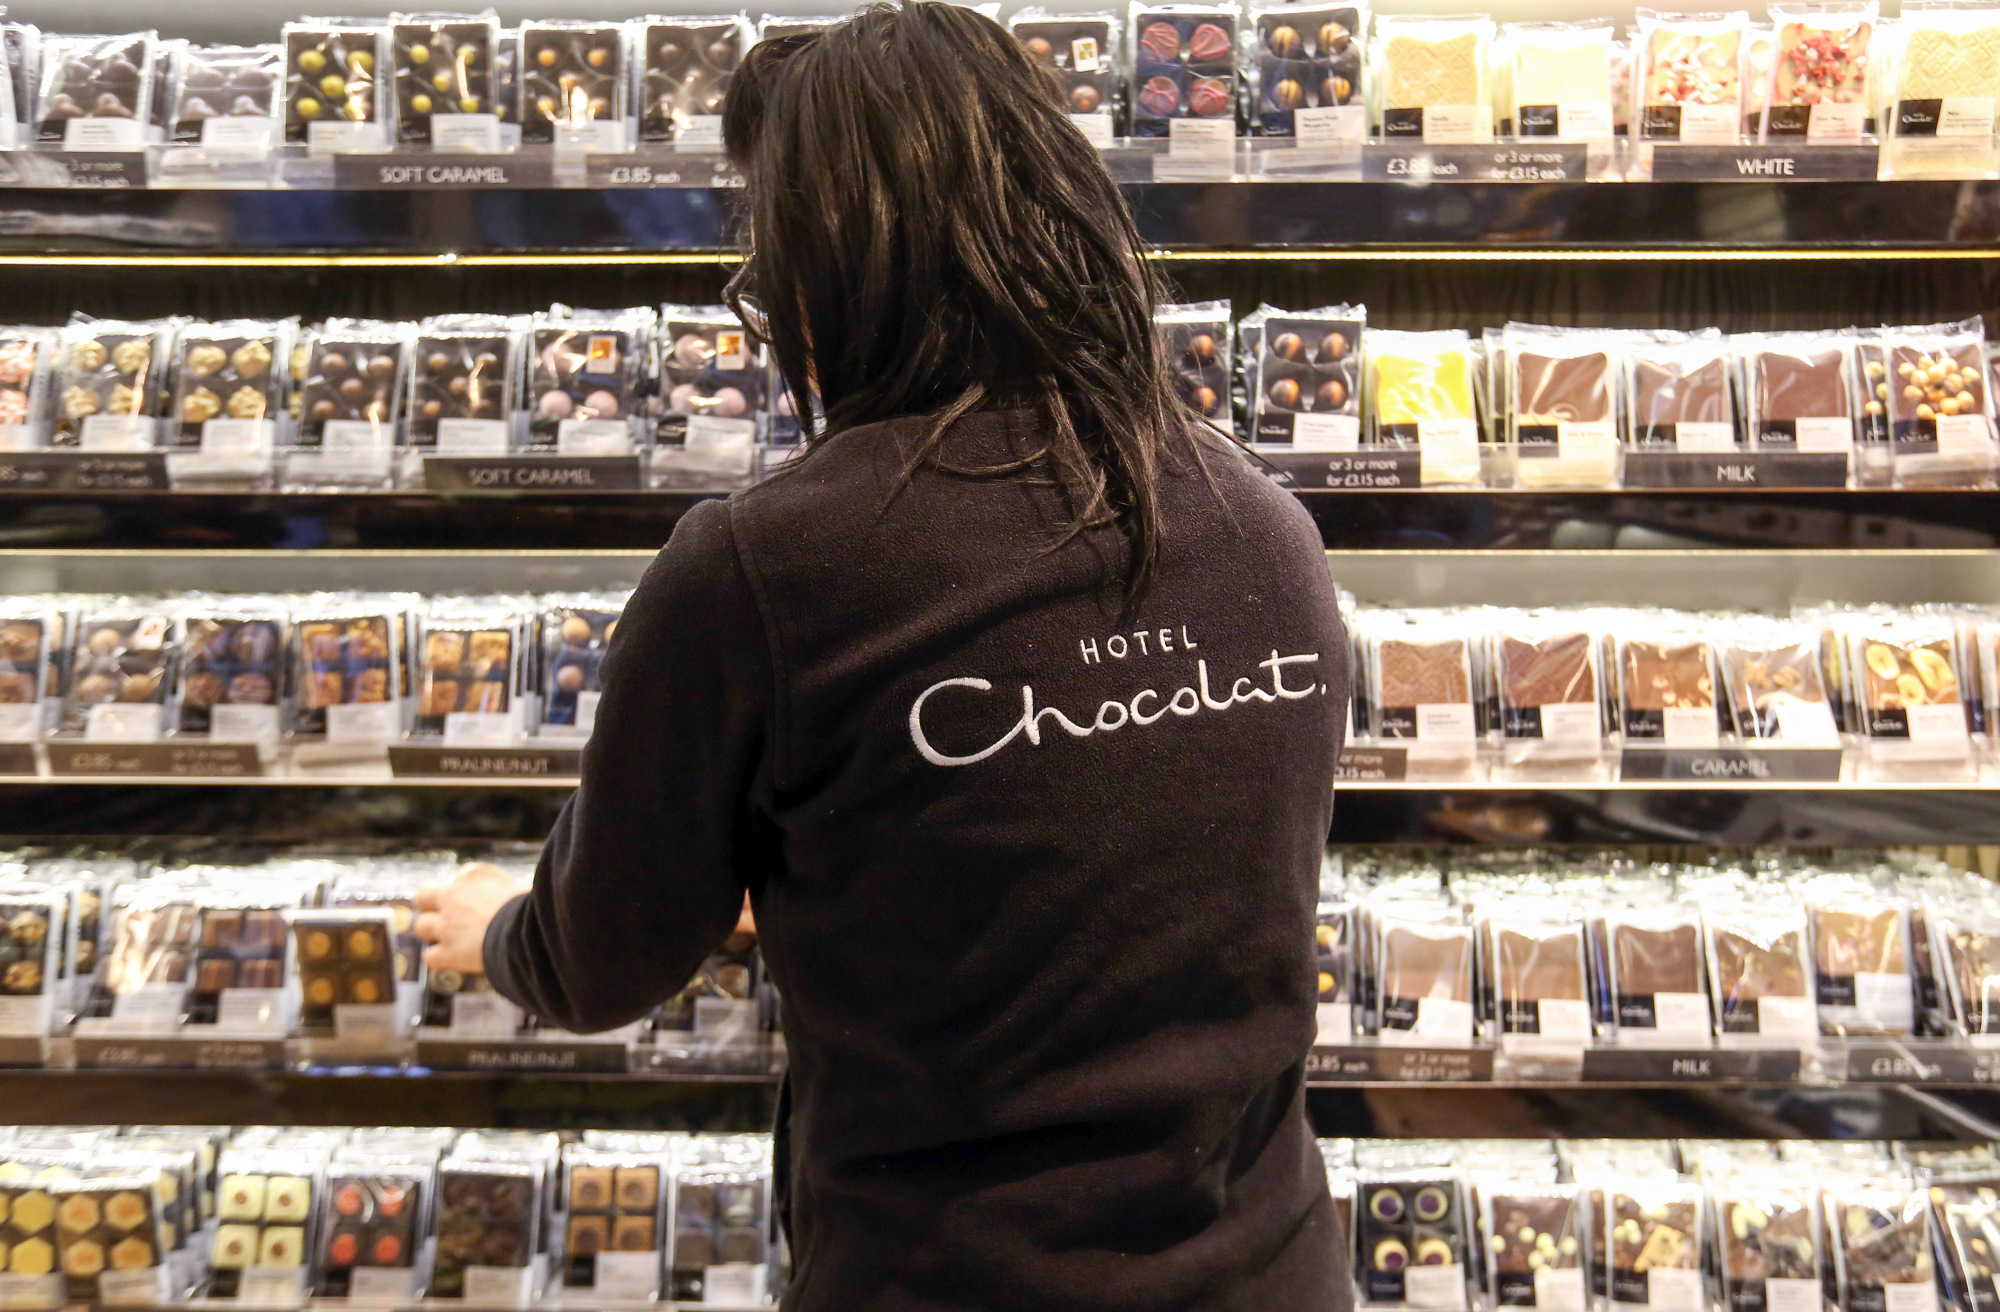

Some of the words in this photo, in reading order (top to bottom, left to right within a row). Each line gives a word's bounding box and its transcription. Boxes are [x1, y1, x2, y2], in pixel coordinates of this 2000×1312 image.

[1494, 153, 1508, 163] or
[1508, 151, 1517, 163] 3
[1519, 153, 1533, 163] or
[1532, 153, 1564, 163] more
[380, 166, 424, 183] SOFT
[426, 166, 509, 183] CARAMEL
[1432, 162, 1459, 175] each
[1540, 167, 1566, 180] each
[1736, 158, 1795, 175] WHITE
[1329, 461, 1343, 471] or
[1344, 458, 1352, 471] 3
[1353, 461, 1367, 471] or
[1368, 461, 1397, 470] more
[469, 468, 512, 485] SOFT
[515, 468, 595, 485] CARAMEL
[1326, 474, 1343, 487] for
[1344, 473, 1374, 487] £3.15
[1375, 474, 1400, 487] each
[1717, 465, 1755, 482] MILK
[1080, 625, 1198, 664] HOTEL
[1691, 759, 1770, 777] CARAMEL
[1672, 1059, 1711, 1076] MILK
